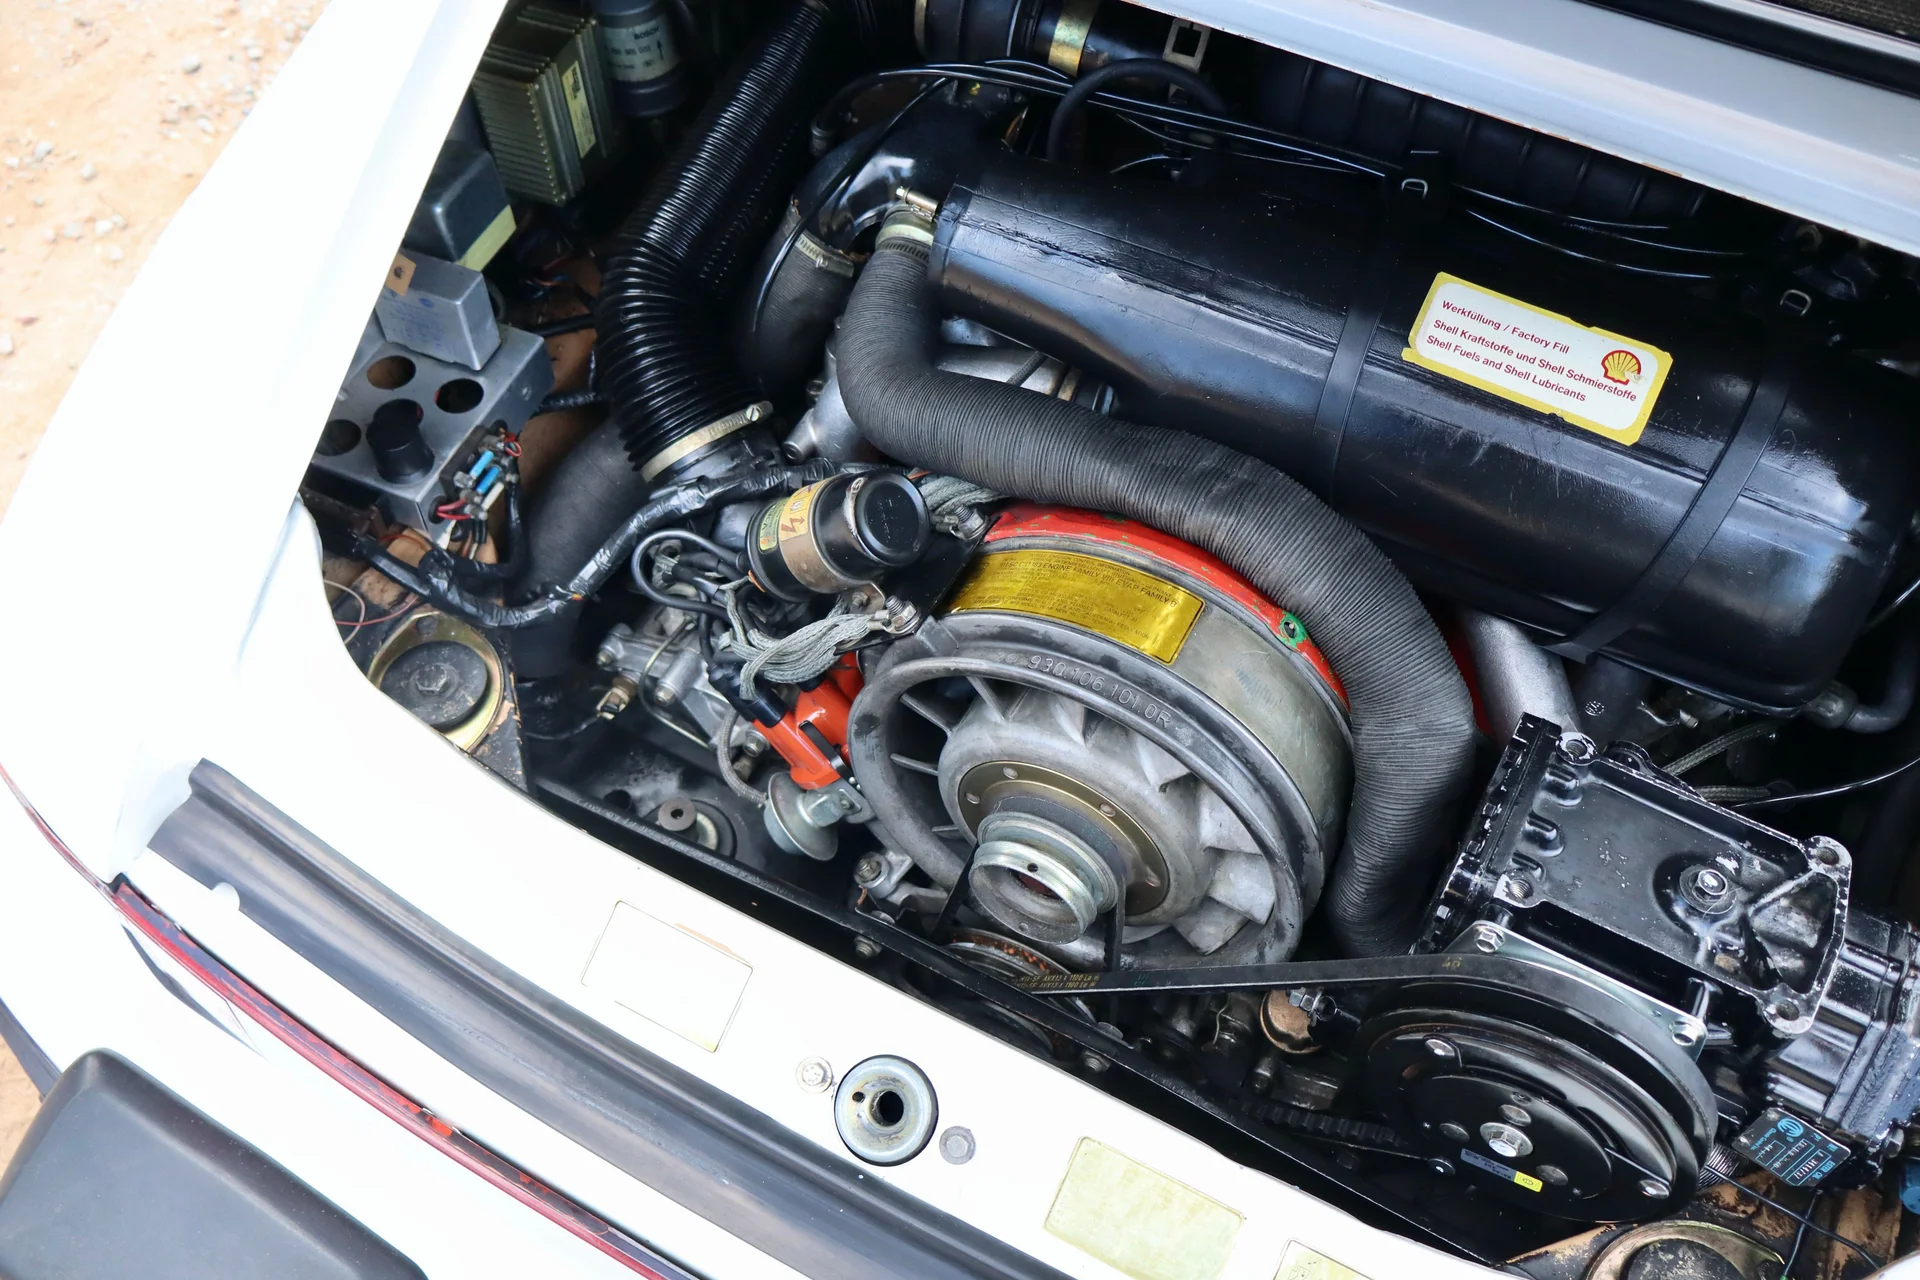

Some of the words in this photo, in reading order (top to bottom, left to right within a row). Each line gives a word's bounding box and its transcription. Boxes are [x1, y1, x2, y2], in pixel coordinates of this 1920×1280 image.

[1441, 300, 1501, 331] Werkfüllung
[1511, 326, 1551, 348] Factory
[1552, 341, 1570, 354] Fill
[1426, 335, 1452, 351] Shell
[1453, 345, 1480, 362] Fuels
[1482, 357, 1502, 370] and
[1504, 363, 1531, 381] Shell
[1532, 374, 1586, 402] Lubricants
[1433, 319, 1459, 335] Shell
[1460, 330, 1514, 357] Kraftstoffe
[1516, 352, 1535, 365] und
[1537, 358, 1565, 375] Shell
[1566, 369, 1637, 402] Schmierstoffe
[1043, 562, 1071, 571] ENGINE
[1073, 567, 1101, 578] FAMILY
[1116, 579, 1139, 590] EVAP
[1140, 587, 1169, 604] FAMILY
